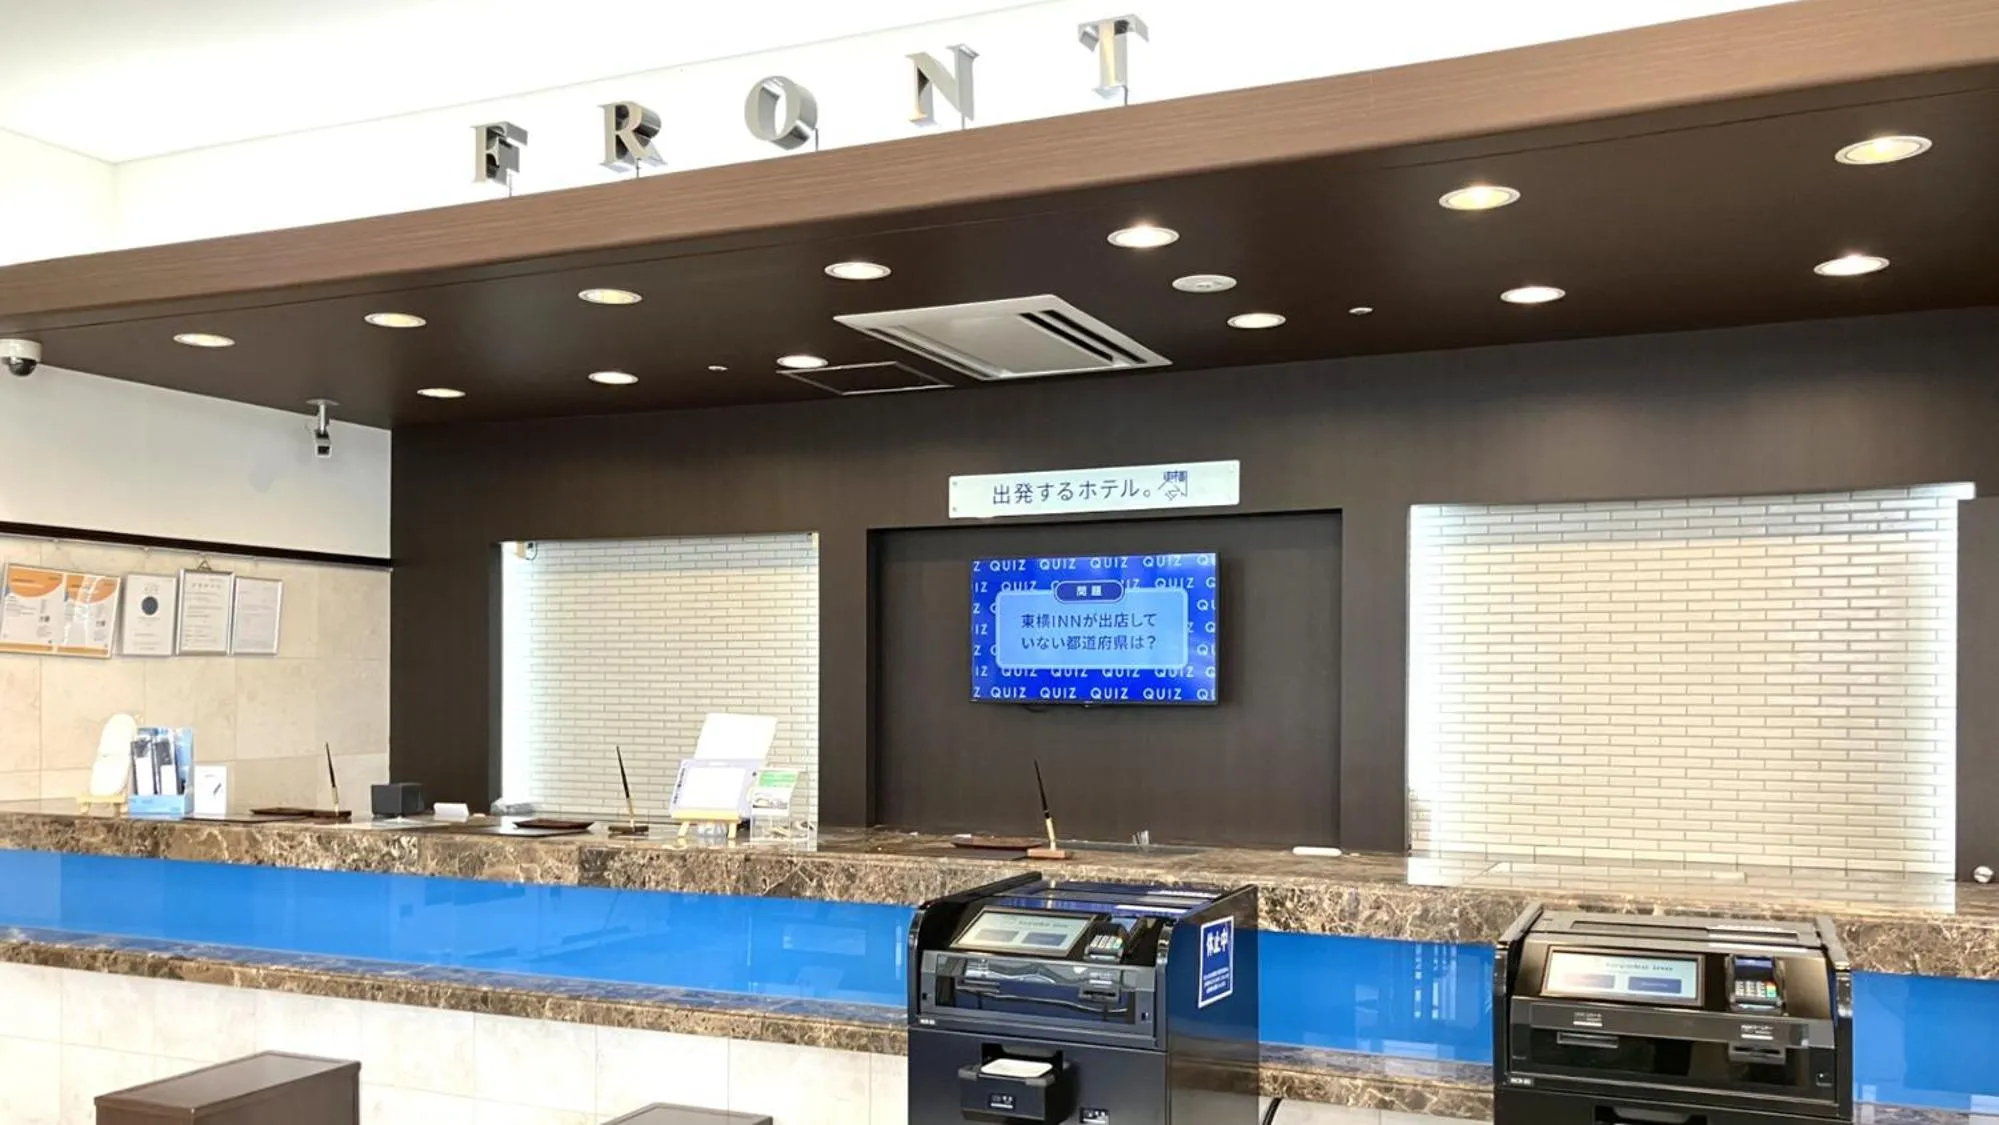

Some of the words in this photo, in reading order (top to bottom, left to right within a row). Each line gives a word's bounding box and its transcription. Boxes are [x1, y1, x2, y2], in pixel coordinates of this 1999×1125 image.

[472, 14, 1149, 185] FRONT
[993, 479, 1151, 505] 出発するホテル。
[989, 560, 1026, 572] QUIZ
[1040, 558, 1077, 570] QUIZ
[1091, 557, 1129, 568] QUIZ
[1143, 555, 1182, 567] QUIZ
[1001, 581, 1037, 591] QUIZ
[1155, 577, 1195, 589] QUIZ
[1021, 613, 1157, 629] 東横INNが出店して
[1001, 668, 1038, 677] QUIZ
[1051, 668, 1088, 677] QUIZ
[1102, 668, 1140, 678] QUIZ
[1154, 666, 1195, 678] QUIZ
[990, 687, 1027, 699] QUIZ
[1040, 687, 1077, 699] QUIZ
[1091, 687, 1128, 700] QUIZ
[1143, 688, 1182, 700] QUIZ
